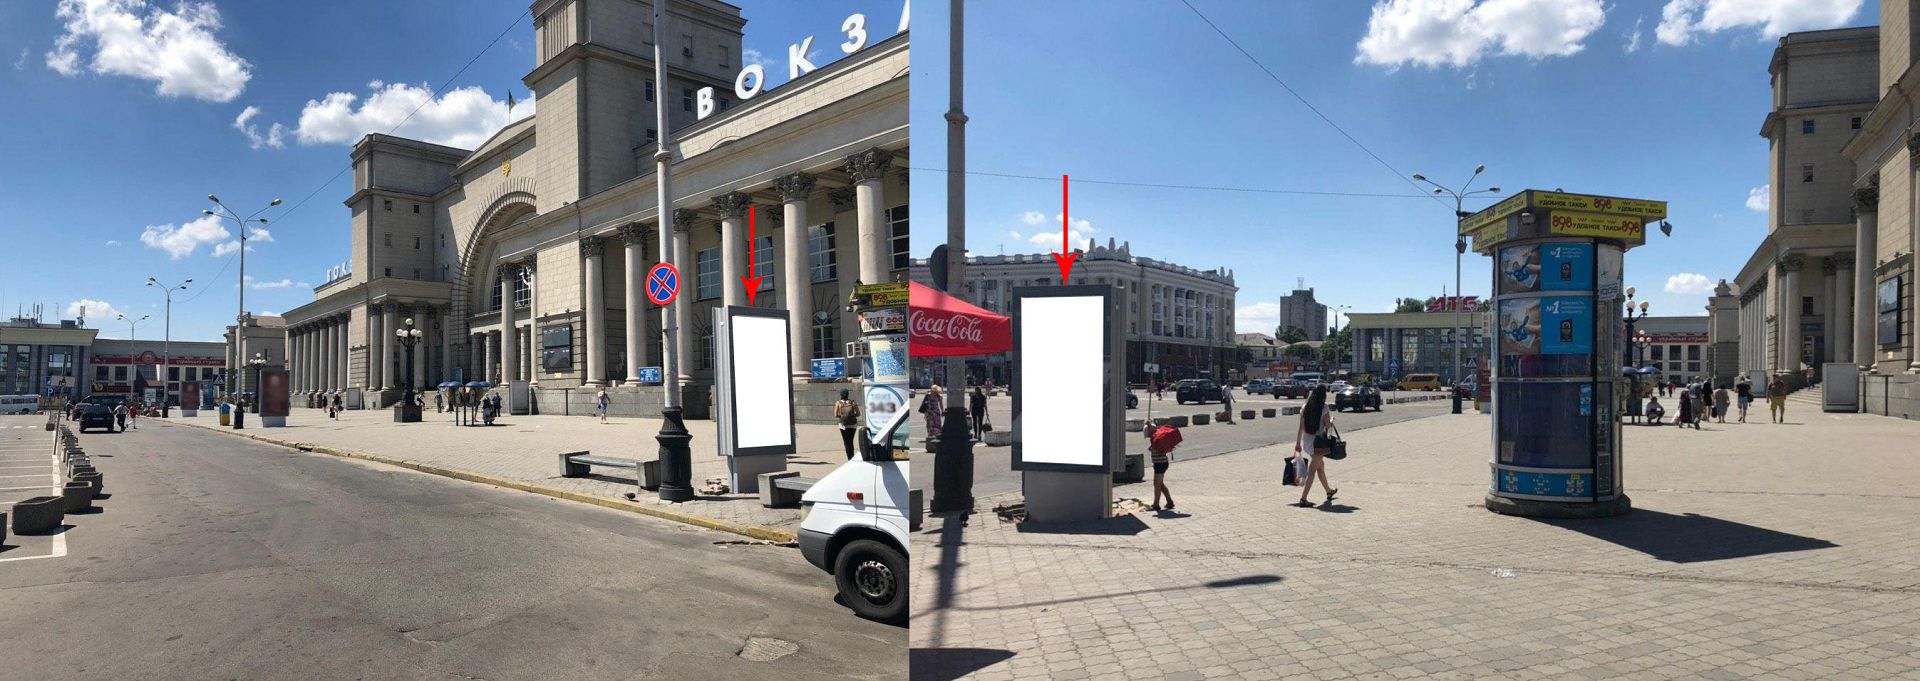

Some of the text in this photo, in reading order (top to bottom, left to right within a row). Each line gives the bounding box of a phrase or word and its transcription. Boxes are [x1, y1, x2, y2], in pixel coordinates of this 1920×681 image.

[1594, 198, 1612, 212] 898
[1552, 215, 1572, 231] 898
[1622, 220, 1640, 235] 898
